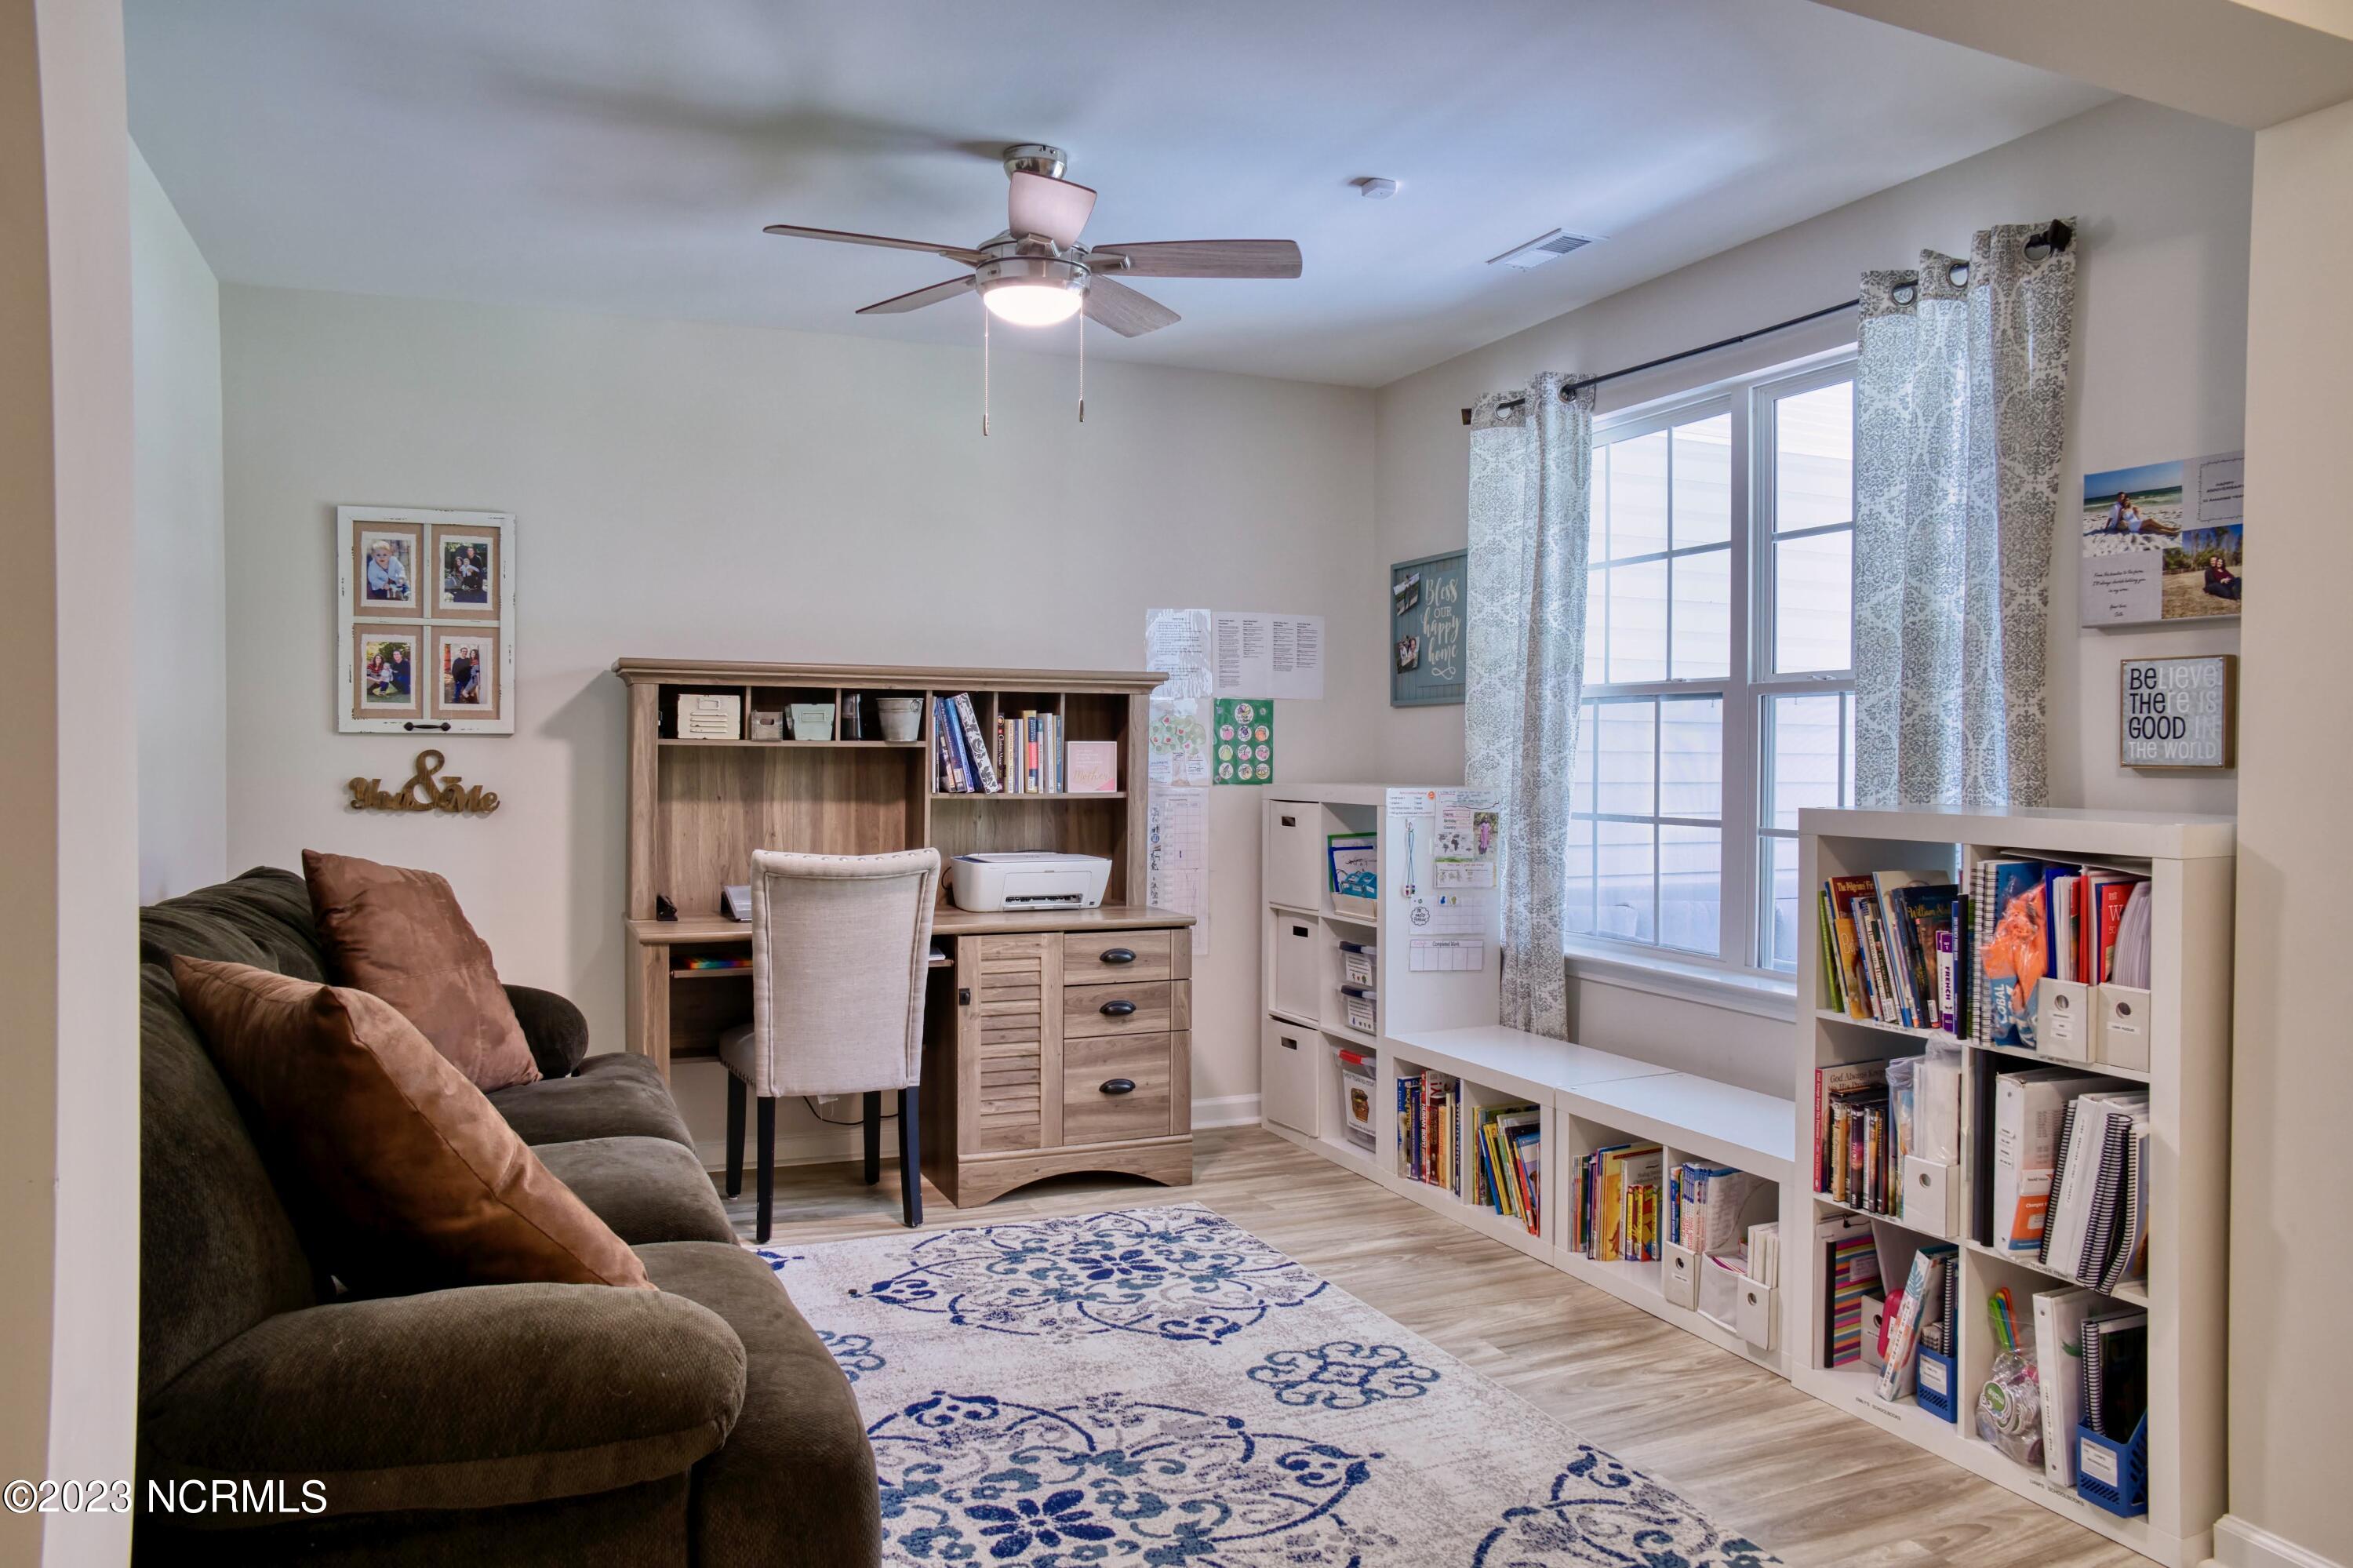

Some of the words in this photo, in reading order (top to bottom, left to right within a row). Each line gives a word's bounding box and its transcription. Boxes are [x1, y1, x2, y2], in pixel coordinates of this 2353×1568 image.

[1425, 577, 1458, 606] Bless
[1420, 606, 1460, 644] happy
[1434, 606, 1453, 618] OUR
[1428, 637, 1457, 671] home
[2129, 716, 2186, 740] GOOD
[401, 749, 462, 811] &
[440, 784, 501, 813] Me
[1837, 882, 1846, 892] The
[1994, 984, 2008, 1024] LOBAL
[1830, 1073, 1843, 1083] God
[1844, 1071, 1867, 1082] Always
